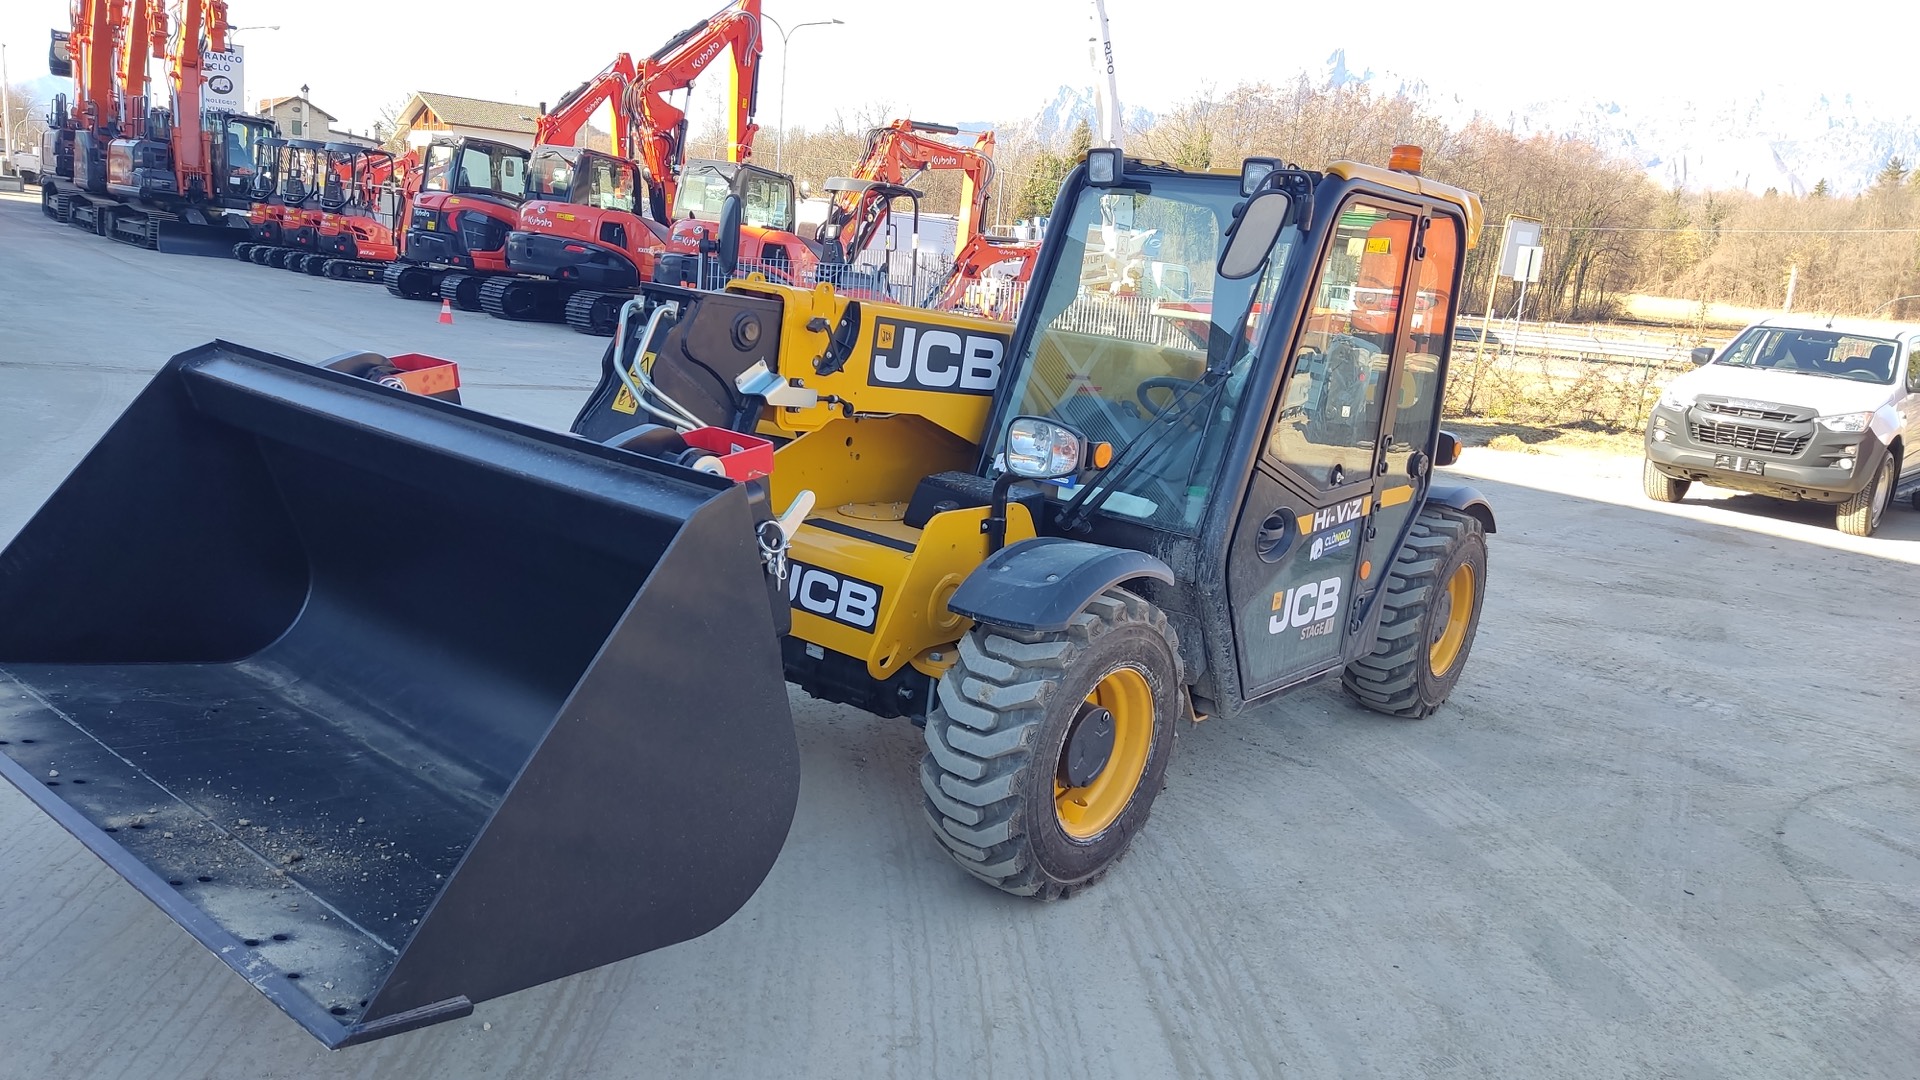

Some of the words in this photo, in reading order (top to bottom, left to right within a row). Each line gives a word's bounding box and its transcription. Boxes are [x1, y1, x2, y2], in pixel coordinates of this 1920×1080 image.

[691, 42, 719, 69] Kubota
[585, 96, 602, 113] Kubota
[931, 156, 957, 165] Kubota
[528, 216, 552, 227] Kubota
[874, 327, 1004, 390] JCB
[1269, 577, 1341, 634] JCB
[1301, 622, 1324, 640] STAGE
